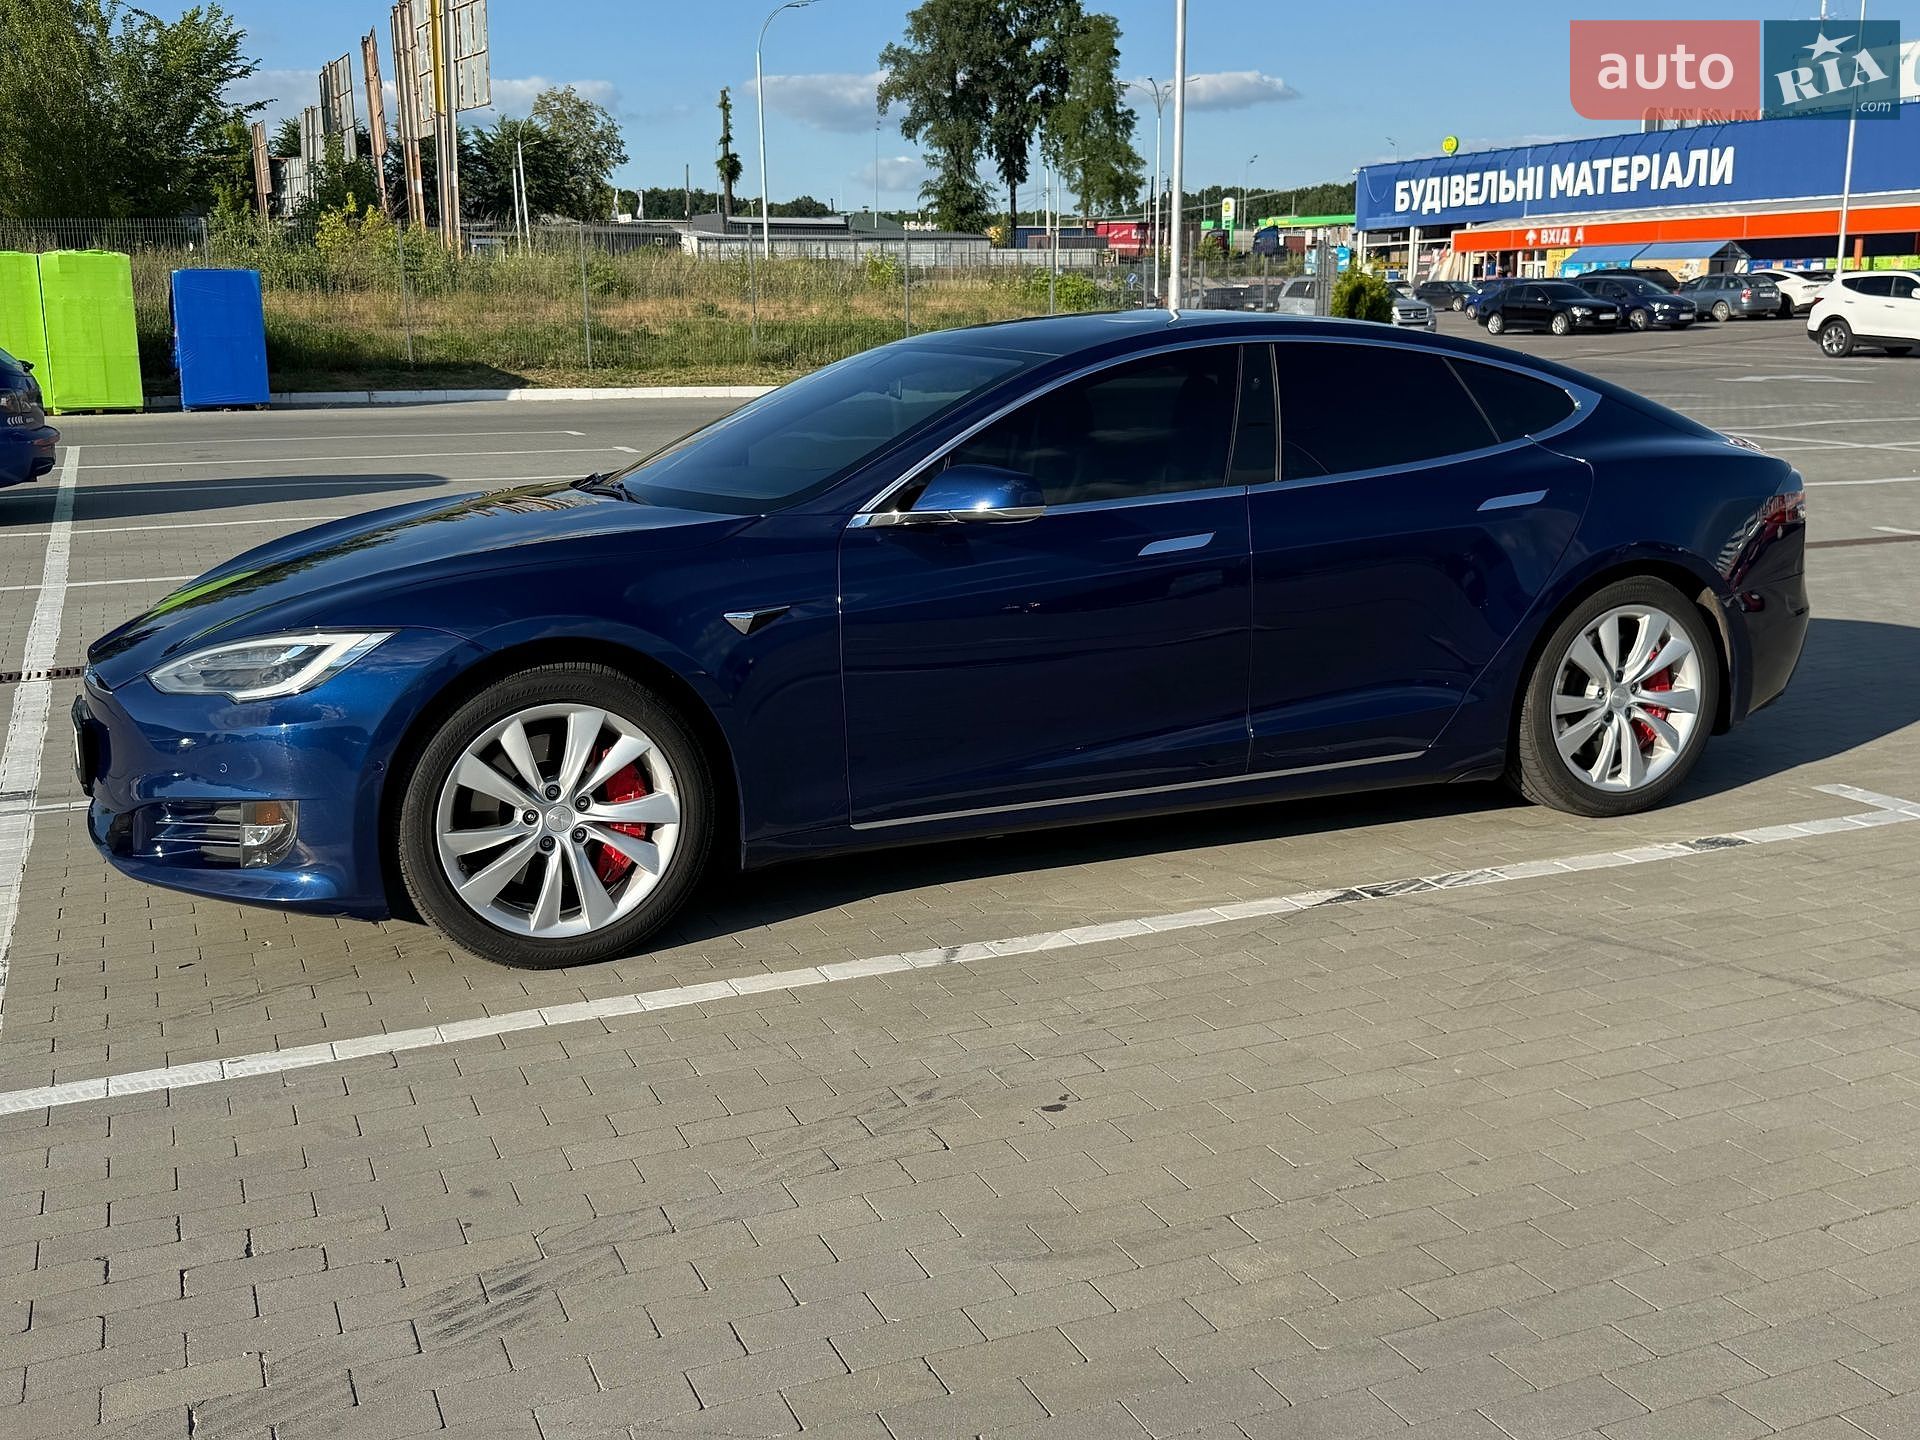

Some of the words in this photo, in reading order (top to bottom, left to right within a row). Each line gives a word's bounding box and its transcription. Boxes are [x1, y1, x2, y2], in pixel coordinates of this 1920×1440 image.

[1395, 166, 1544, 215] БУДІВЕЛЬНІ
[1550, 146, 1735, 199] МАТЕРІАЛИ
[1541, 228, 1570, 245] ВХІД
